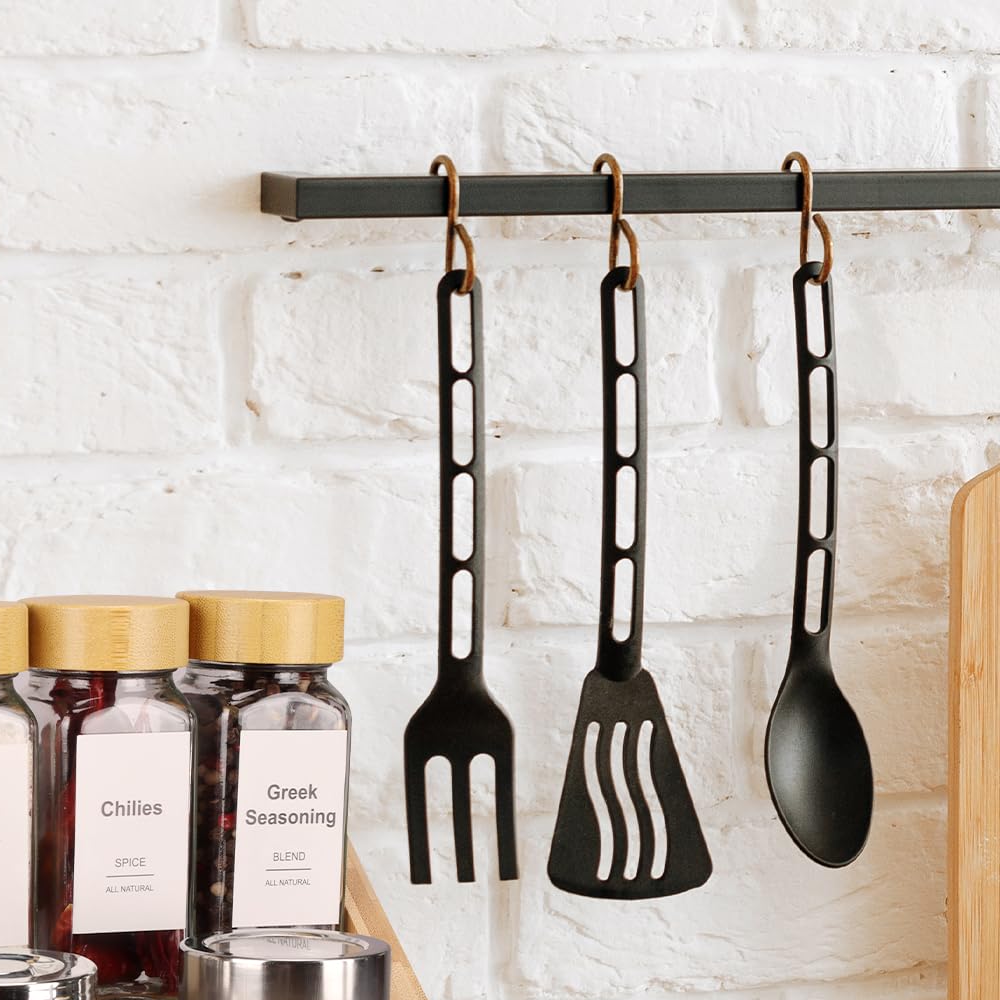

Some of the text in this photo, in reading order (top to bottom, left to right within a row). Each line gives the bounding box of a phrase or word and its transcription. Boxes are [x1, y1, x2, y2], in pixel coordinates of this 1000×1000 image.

[266, 783, 318, 801] Greek
[100, 799, 163, 818] Chilies
[244, 808, 337, 829] Seasoning
[114, 856, 147, 869] SPICE
[272, 851, 306, 862] BLEND
[105, 884, 154, 894] ALL NATURAL
[264, 878, 311, 888] ALL NATURAL
